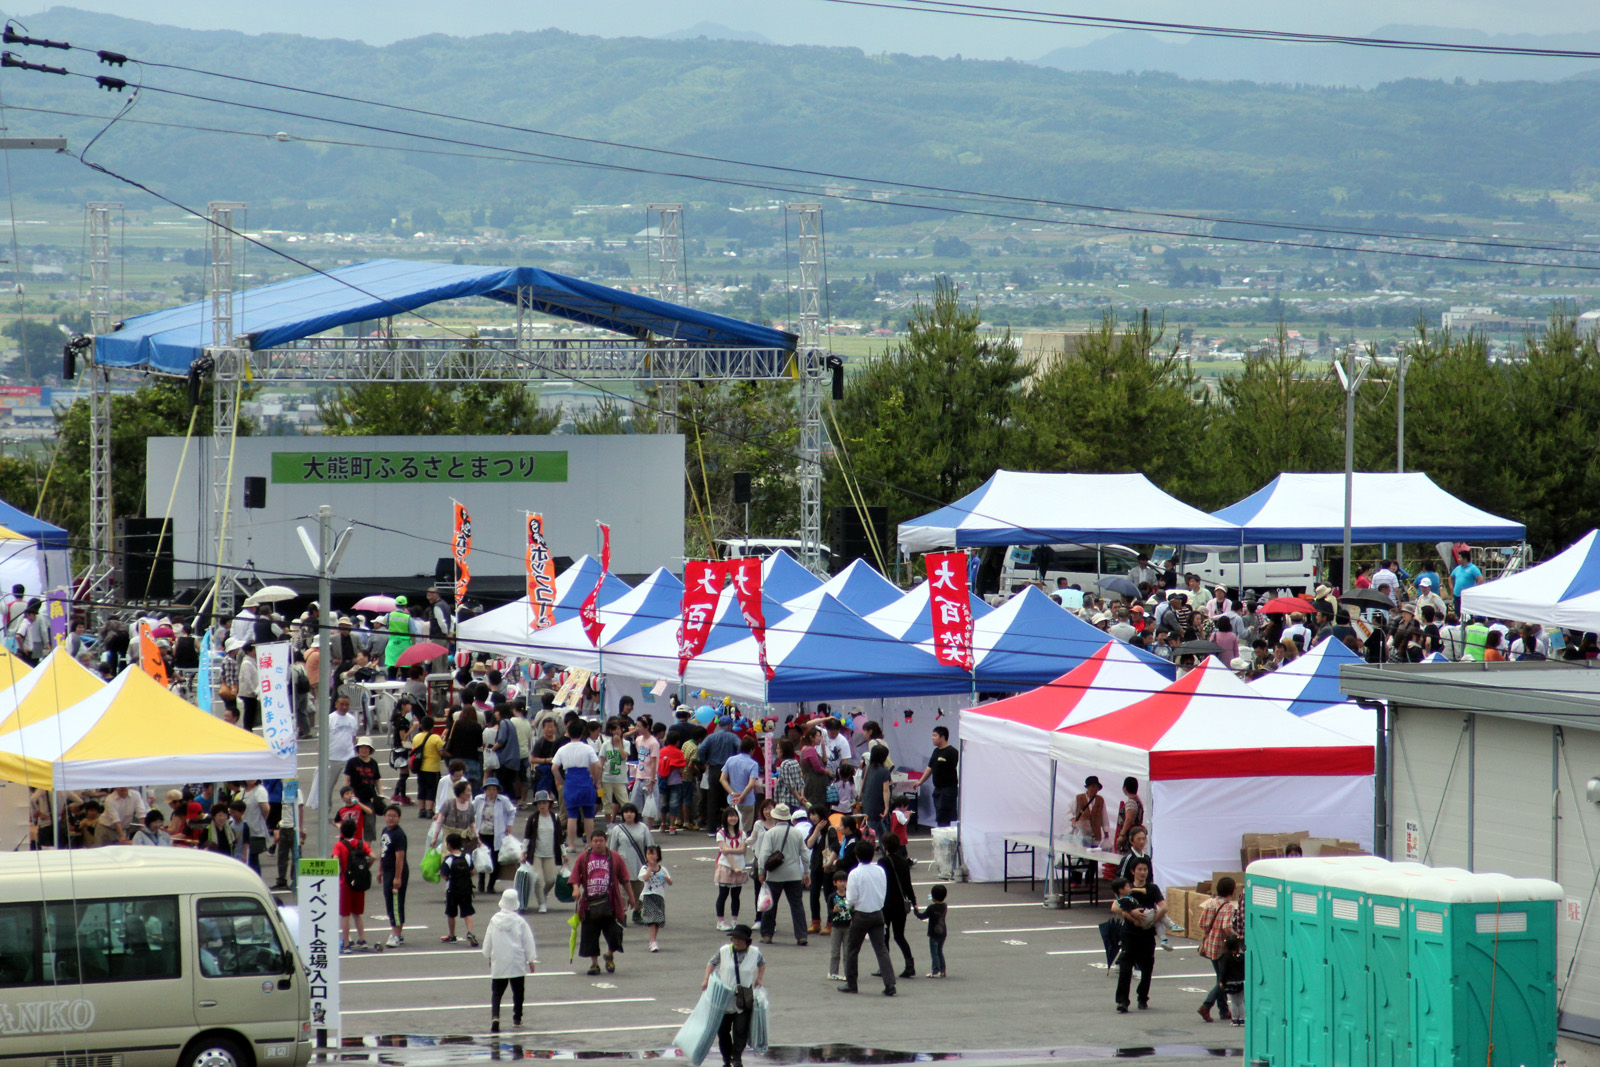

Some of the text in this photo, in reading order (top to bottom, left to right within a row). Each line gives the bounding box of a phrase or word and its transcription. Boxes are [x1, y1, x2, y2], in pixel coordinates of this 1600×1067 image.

[303, 455, 534, 480] 大熊町ふるさとまつり
[259, 656, 281, 752] 縁日おまつり
[308, 878, 328, 999] イベント会場入口
